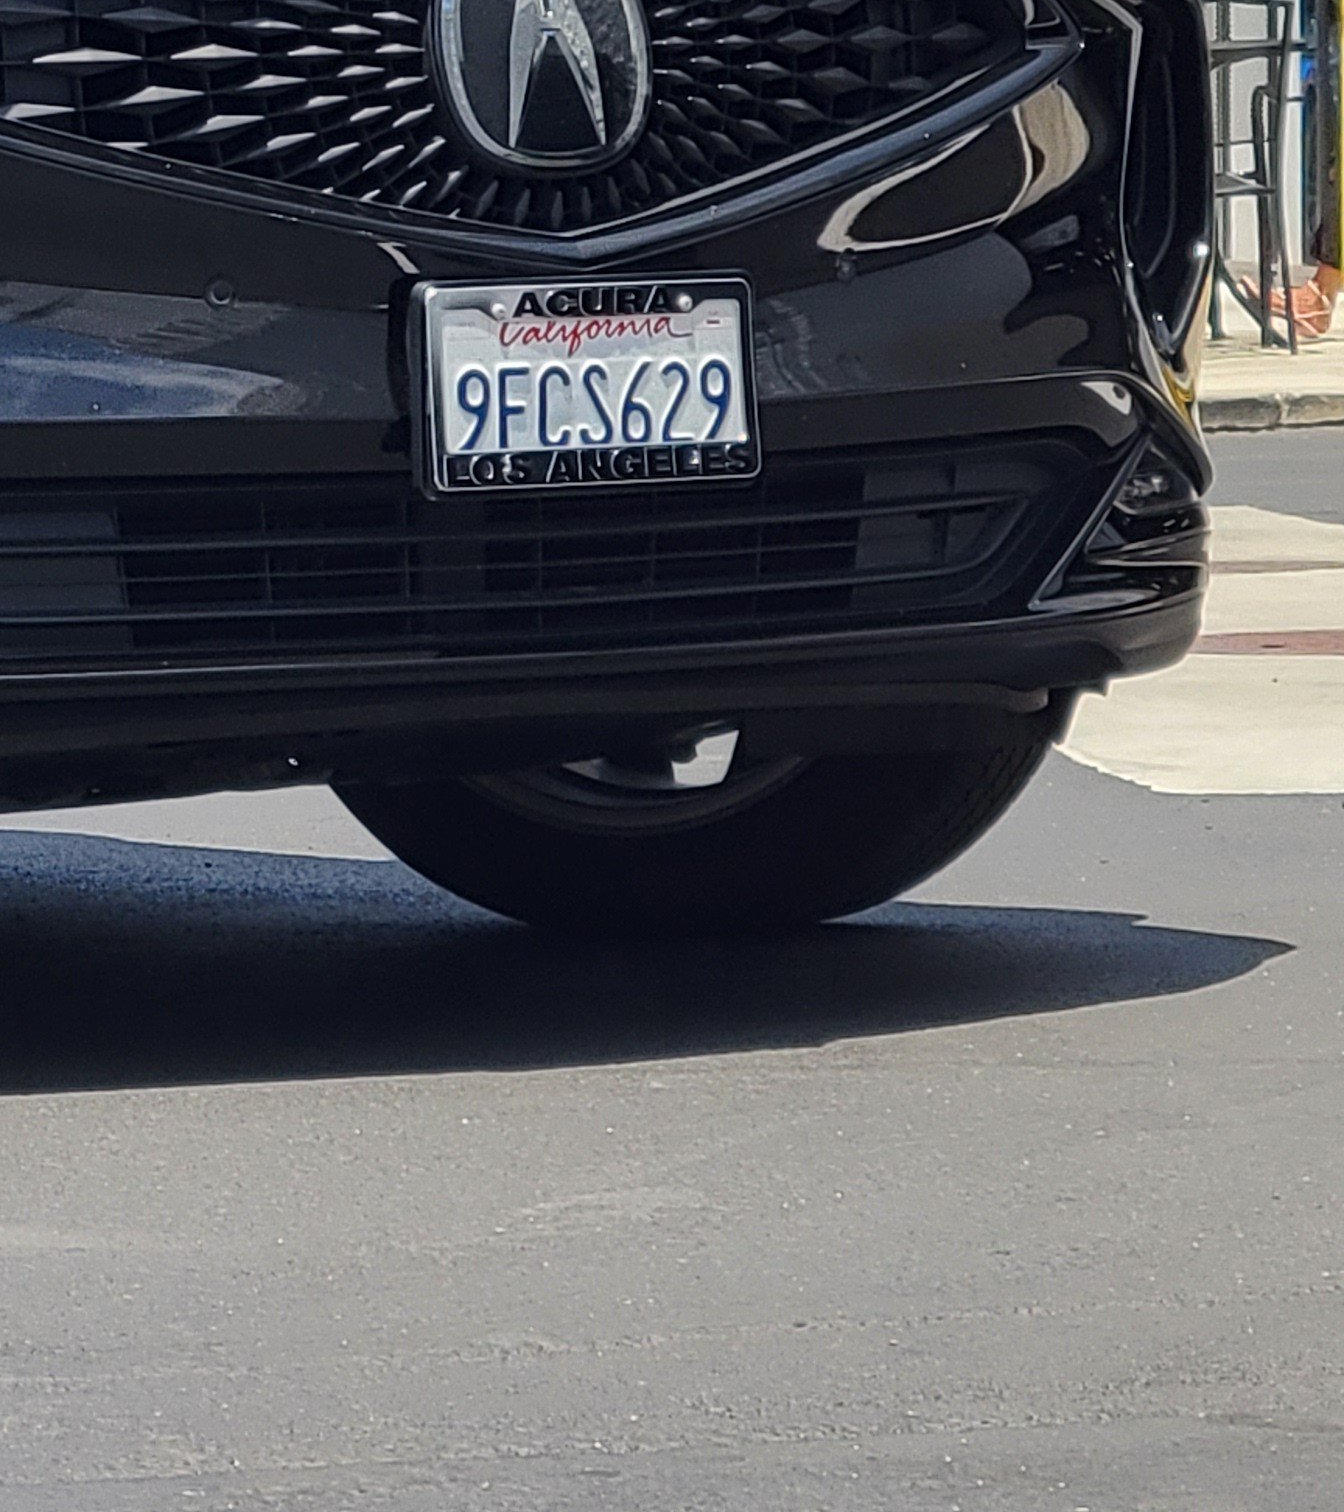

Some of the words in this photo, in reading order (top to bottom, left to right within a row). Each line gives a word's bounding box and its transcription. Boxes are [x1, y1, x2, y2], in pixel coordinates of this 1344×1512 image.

[513, 286, 673, 318] ACURA
[499, 315, 694, 357] California
[455, 358, 732, 451] 9FCS629
[446, 450, 535, 487] LOS
[545, 443, 751, 484] ANGELES
